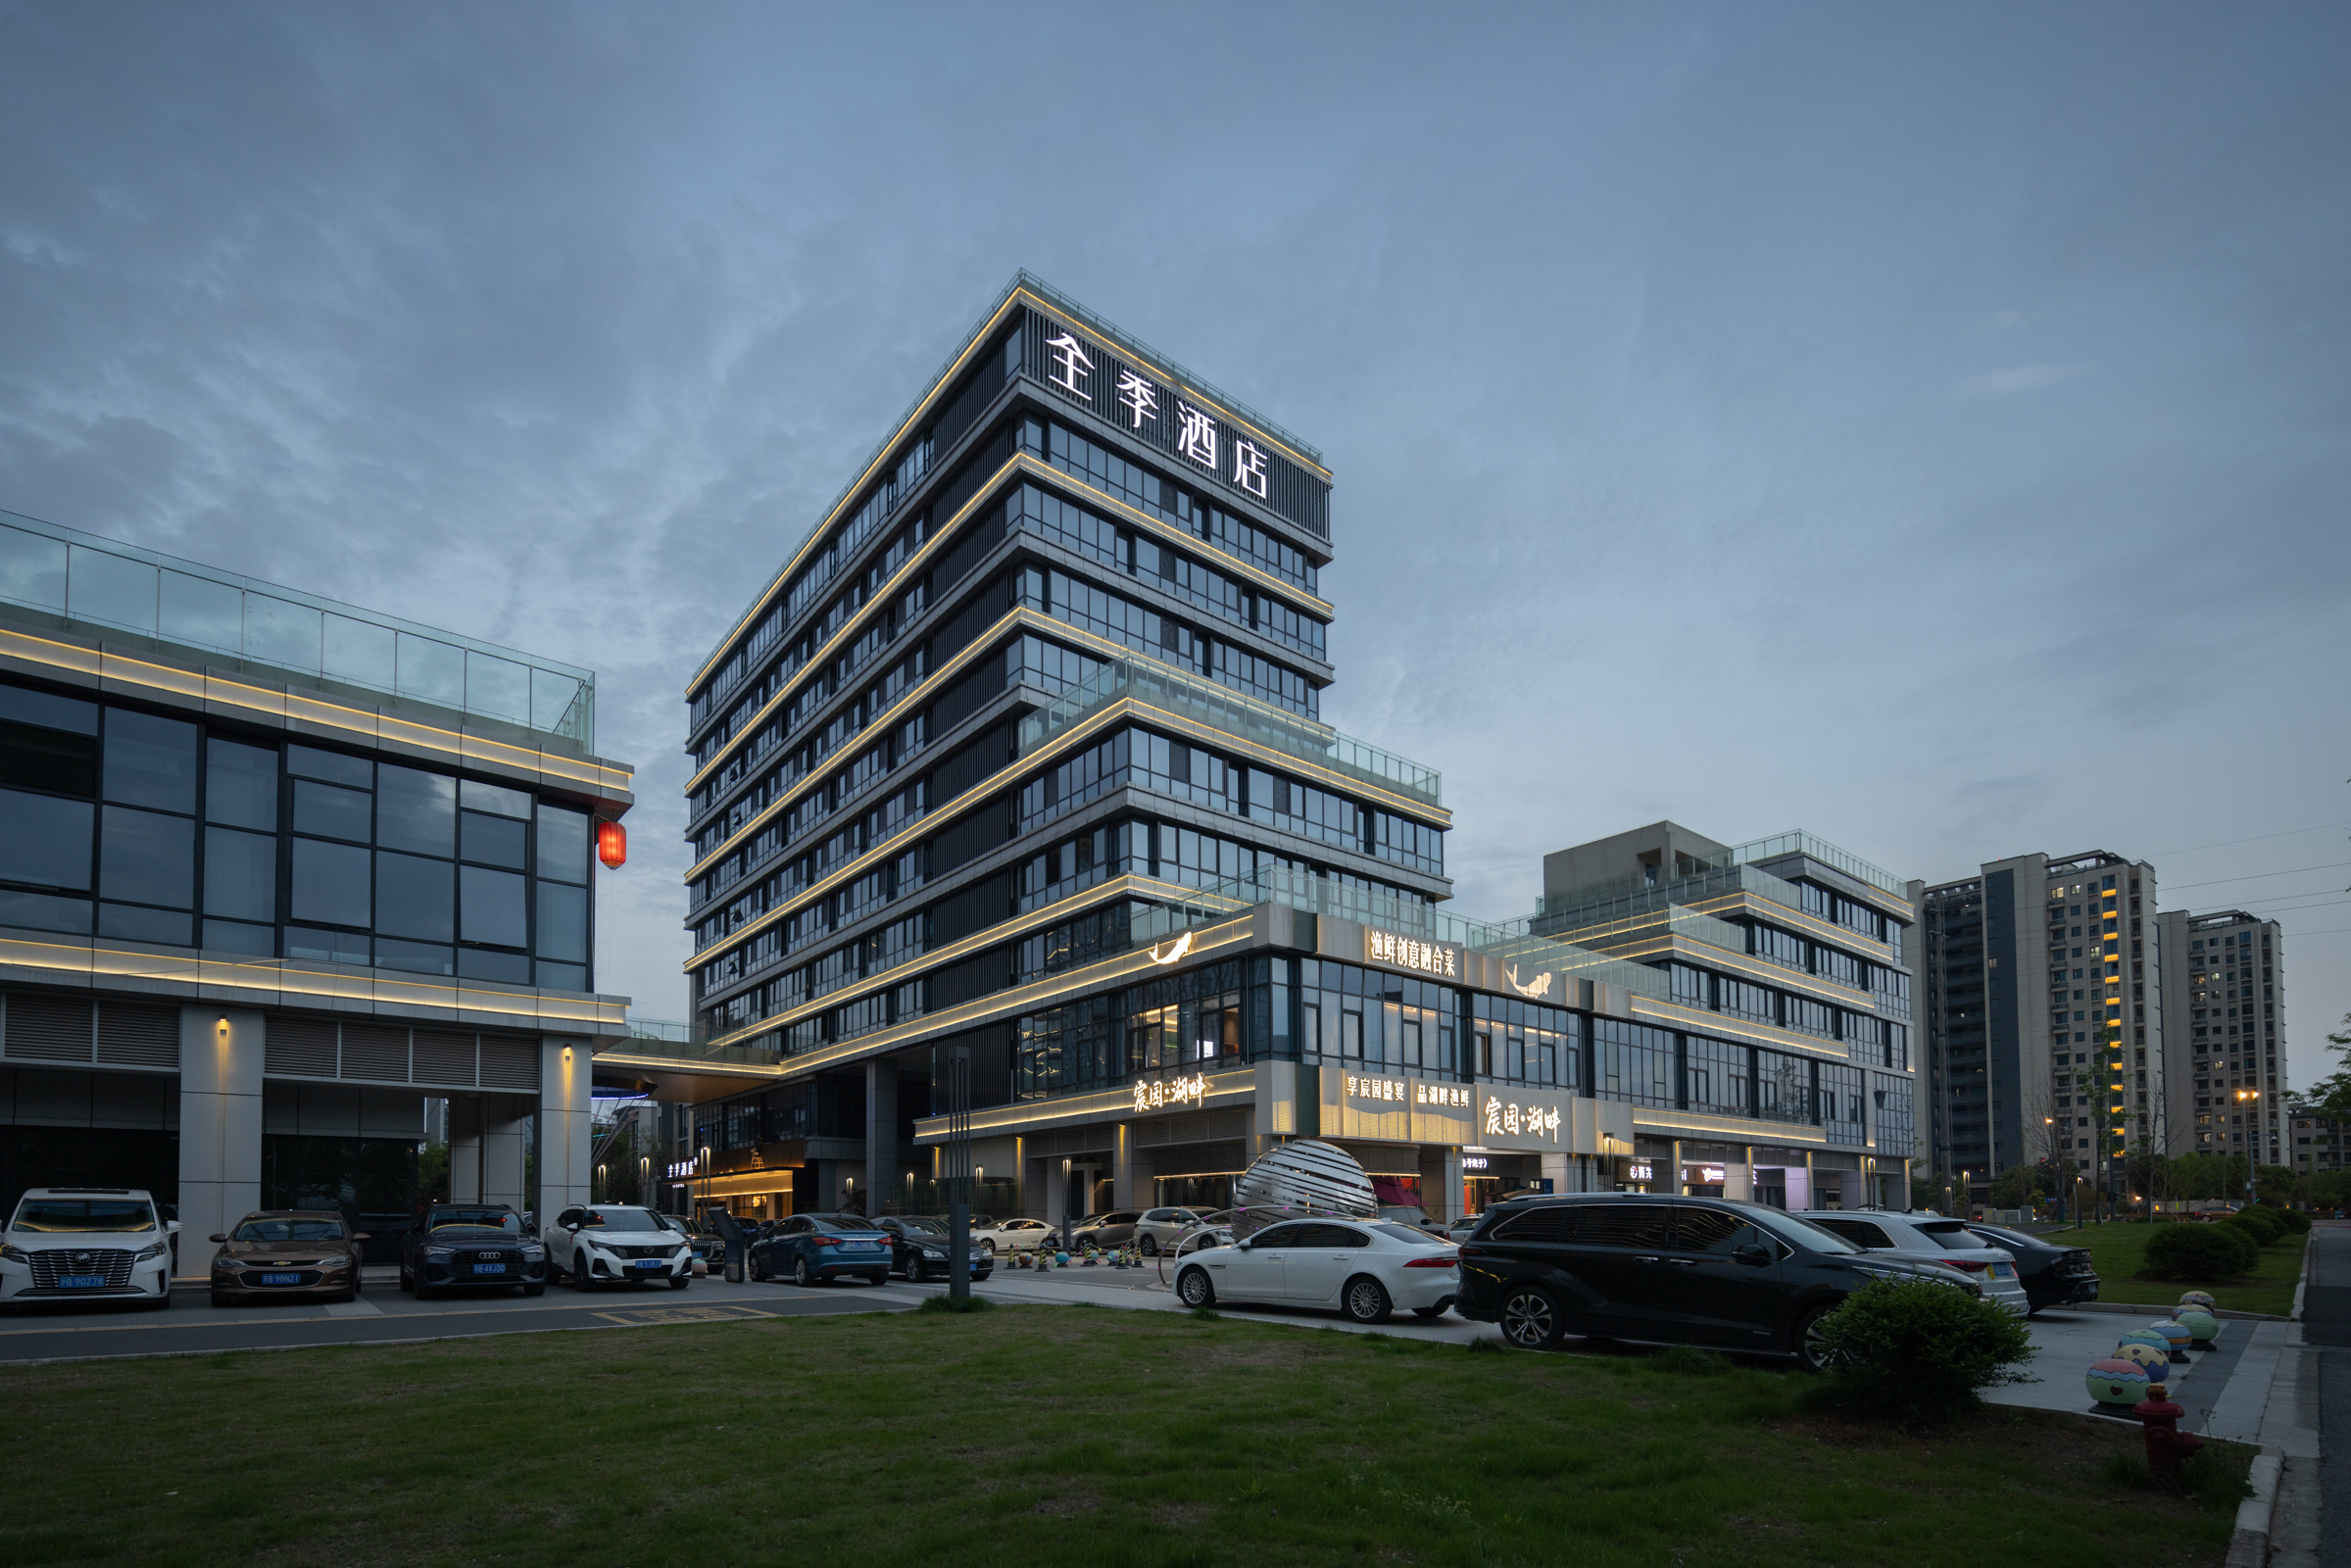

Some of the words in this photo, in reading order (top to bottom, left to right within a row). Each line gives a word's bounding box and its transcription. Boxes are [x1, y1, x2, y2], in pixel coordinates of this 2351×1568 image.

[1046, 332, 1268, 499] 全季酒店
[1370, 930, 1455, 977] 渔鲜创意融合菜
